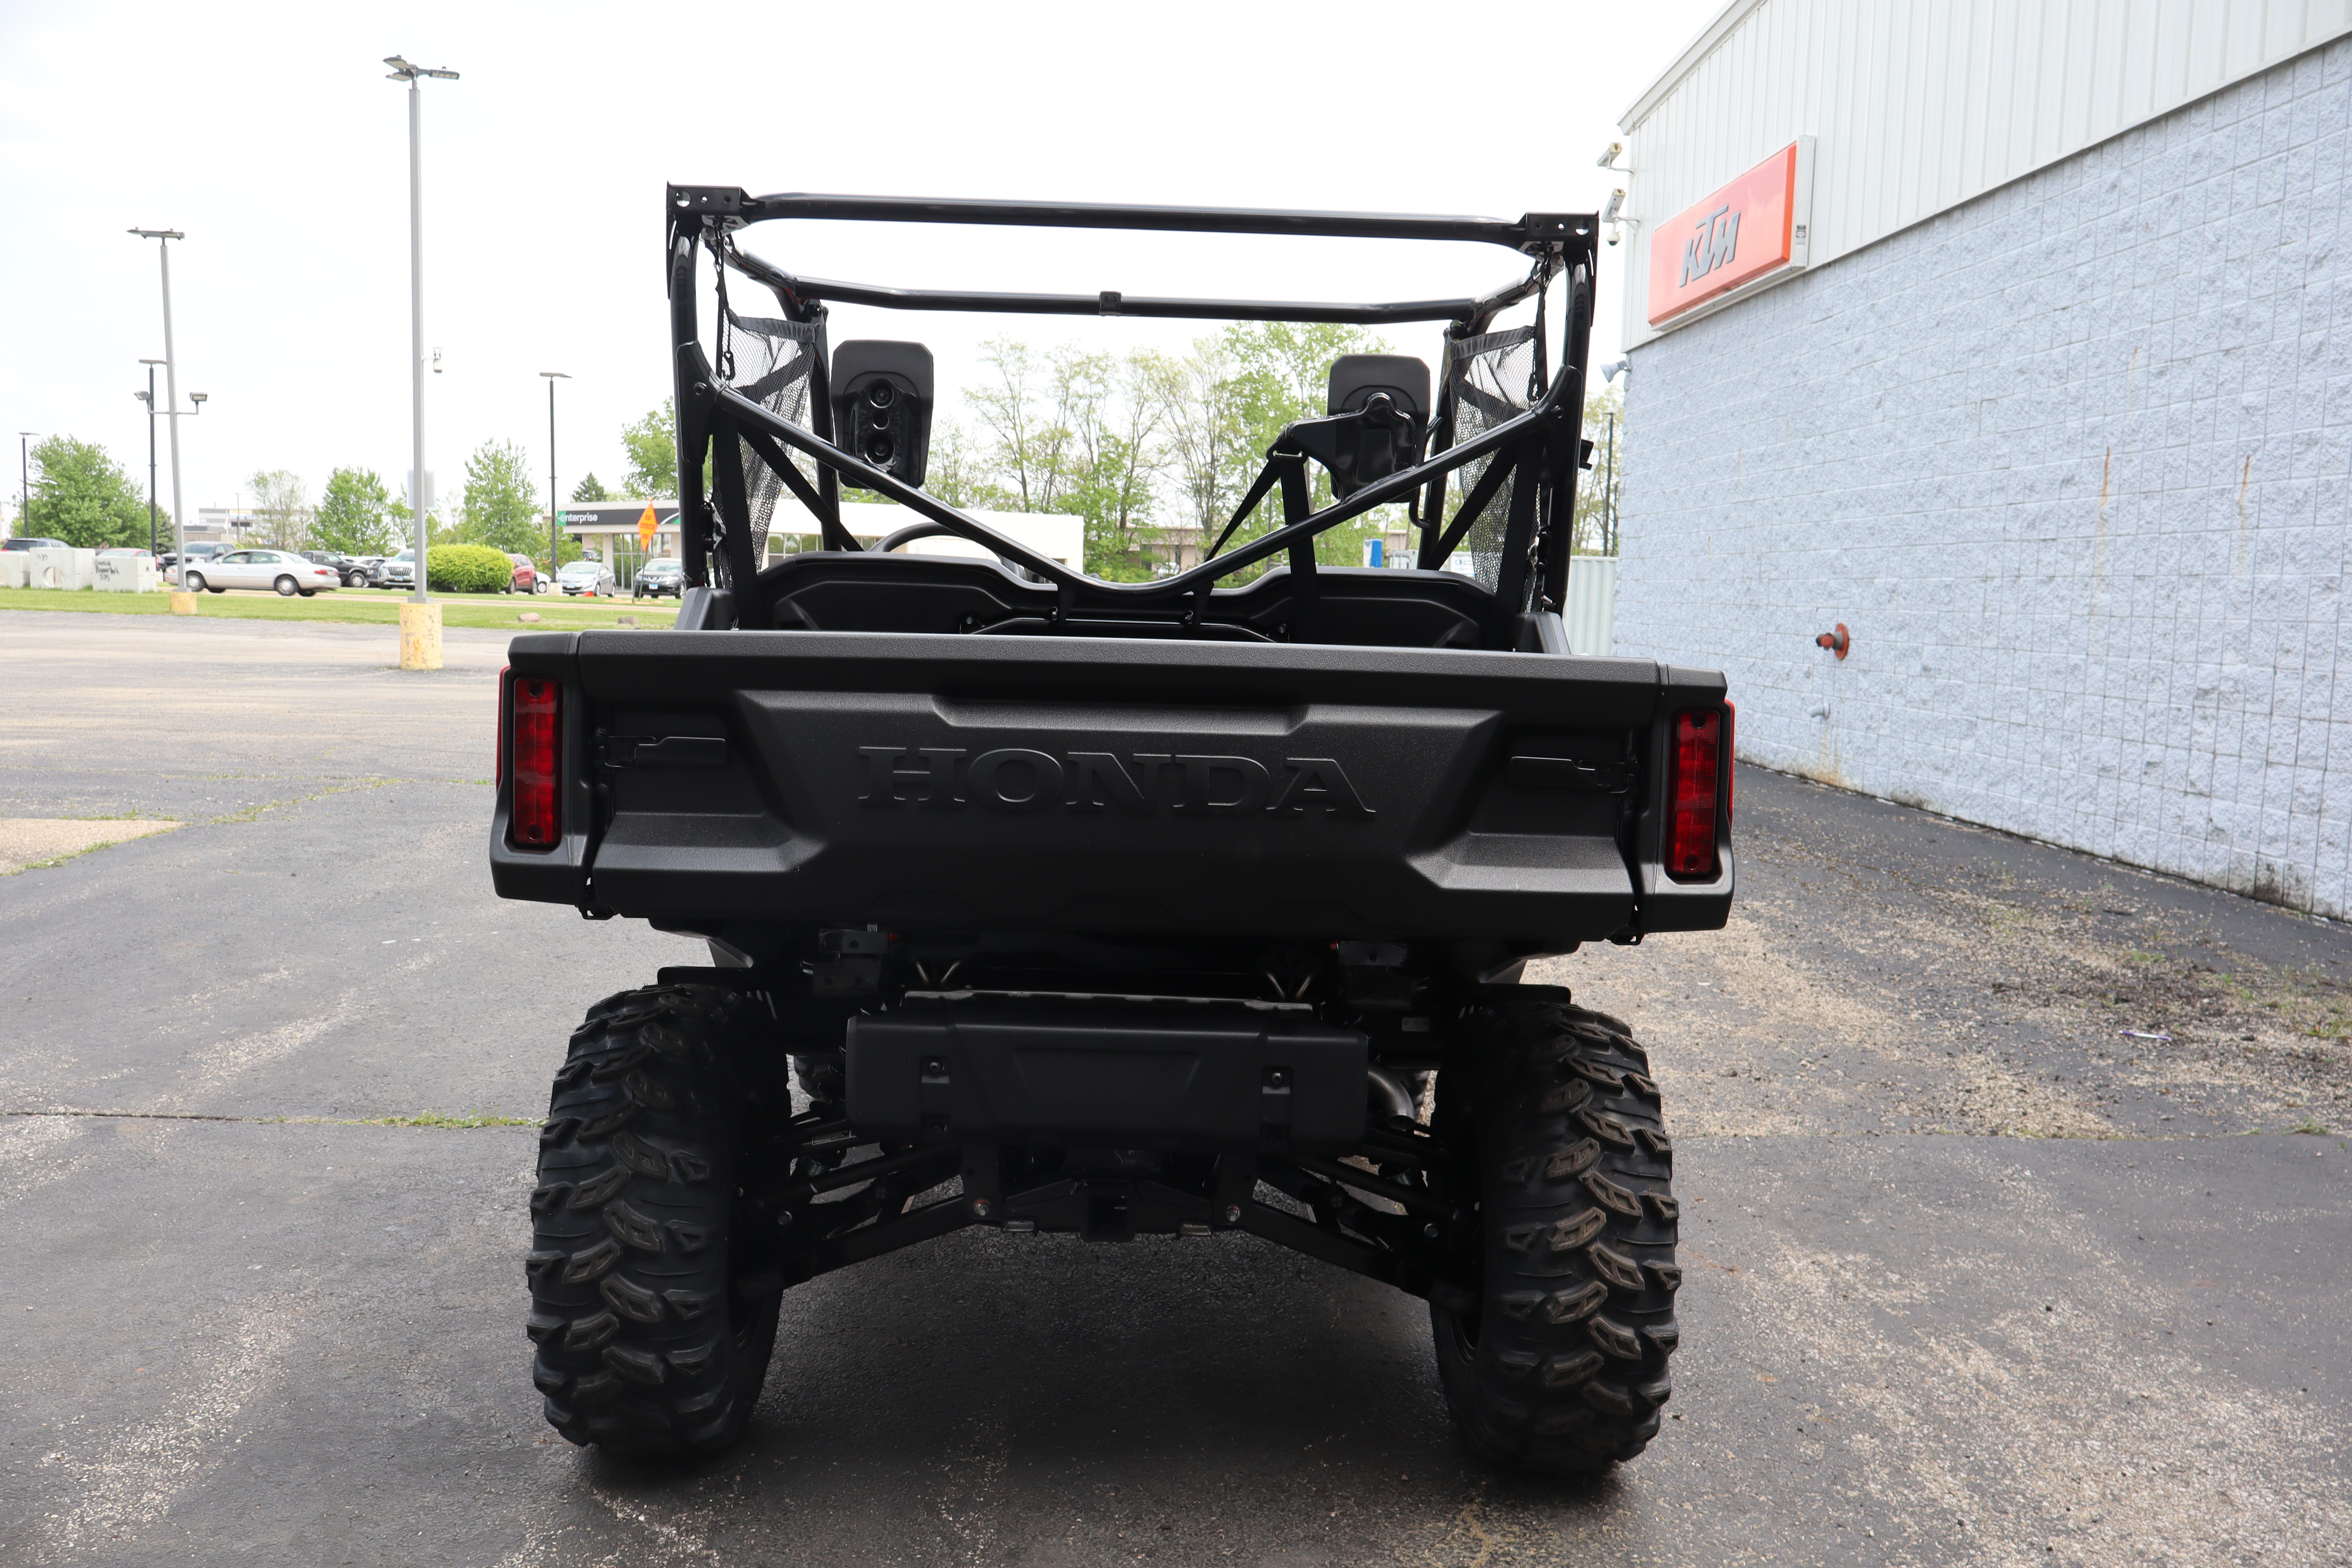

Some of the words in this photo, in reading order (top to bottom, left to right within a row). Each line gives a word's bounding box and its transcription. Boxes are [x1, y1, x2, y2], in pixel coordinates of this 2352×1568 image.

[1679, 203, 1740, 289] KTM
[558, 512, 598, 524] enterprise
[858, 746, 1376, 820] HONDA
